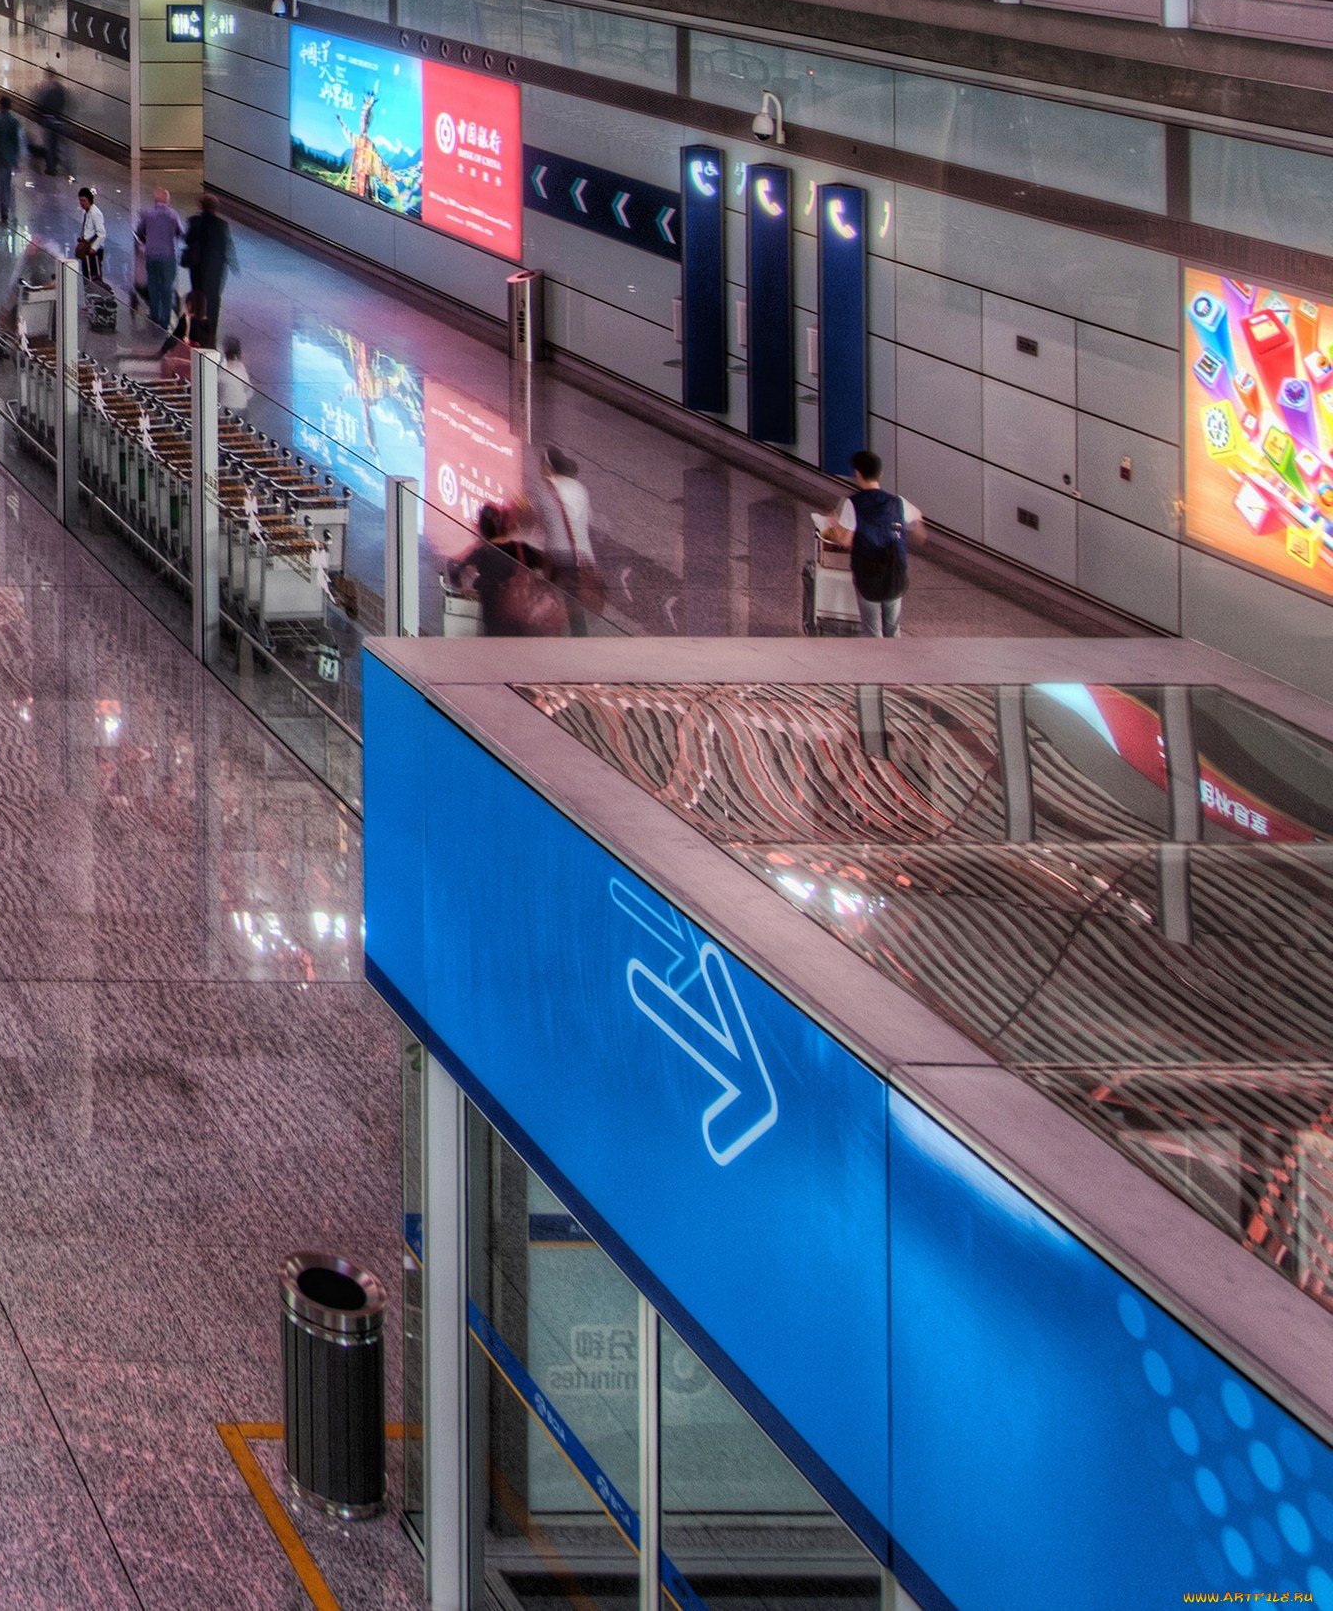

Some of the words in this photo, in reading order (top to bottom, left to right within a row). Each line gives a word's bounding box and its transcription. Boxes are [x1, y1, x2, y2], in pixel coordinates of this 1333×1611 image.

[457, 119, 502, 156] 中国银行
[458, 148, 474, 161] BANK
[482, 155, 502, 171] CHINA
[517, 310, 526, 343] waste
